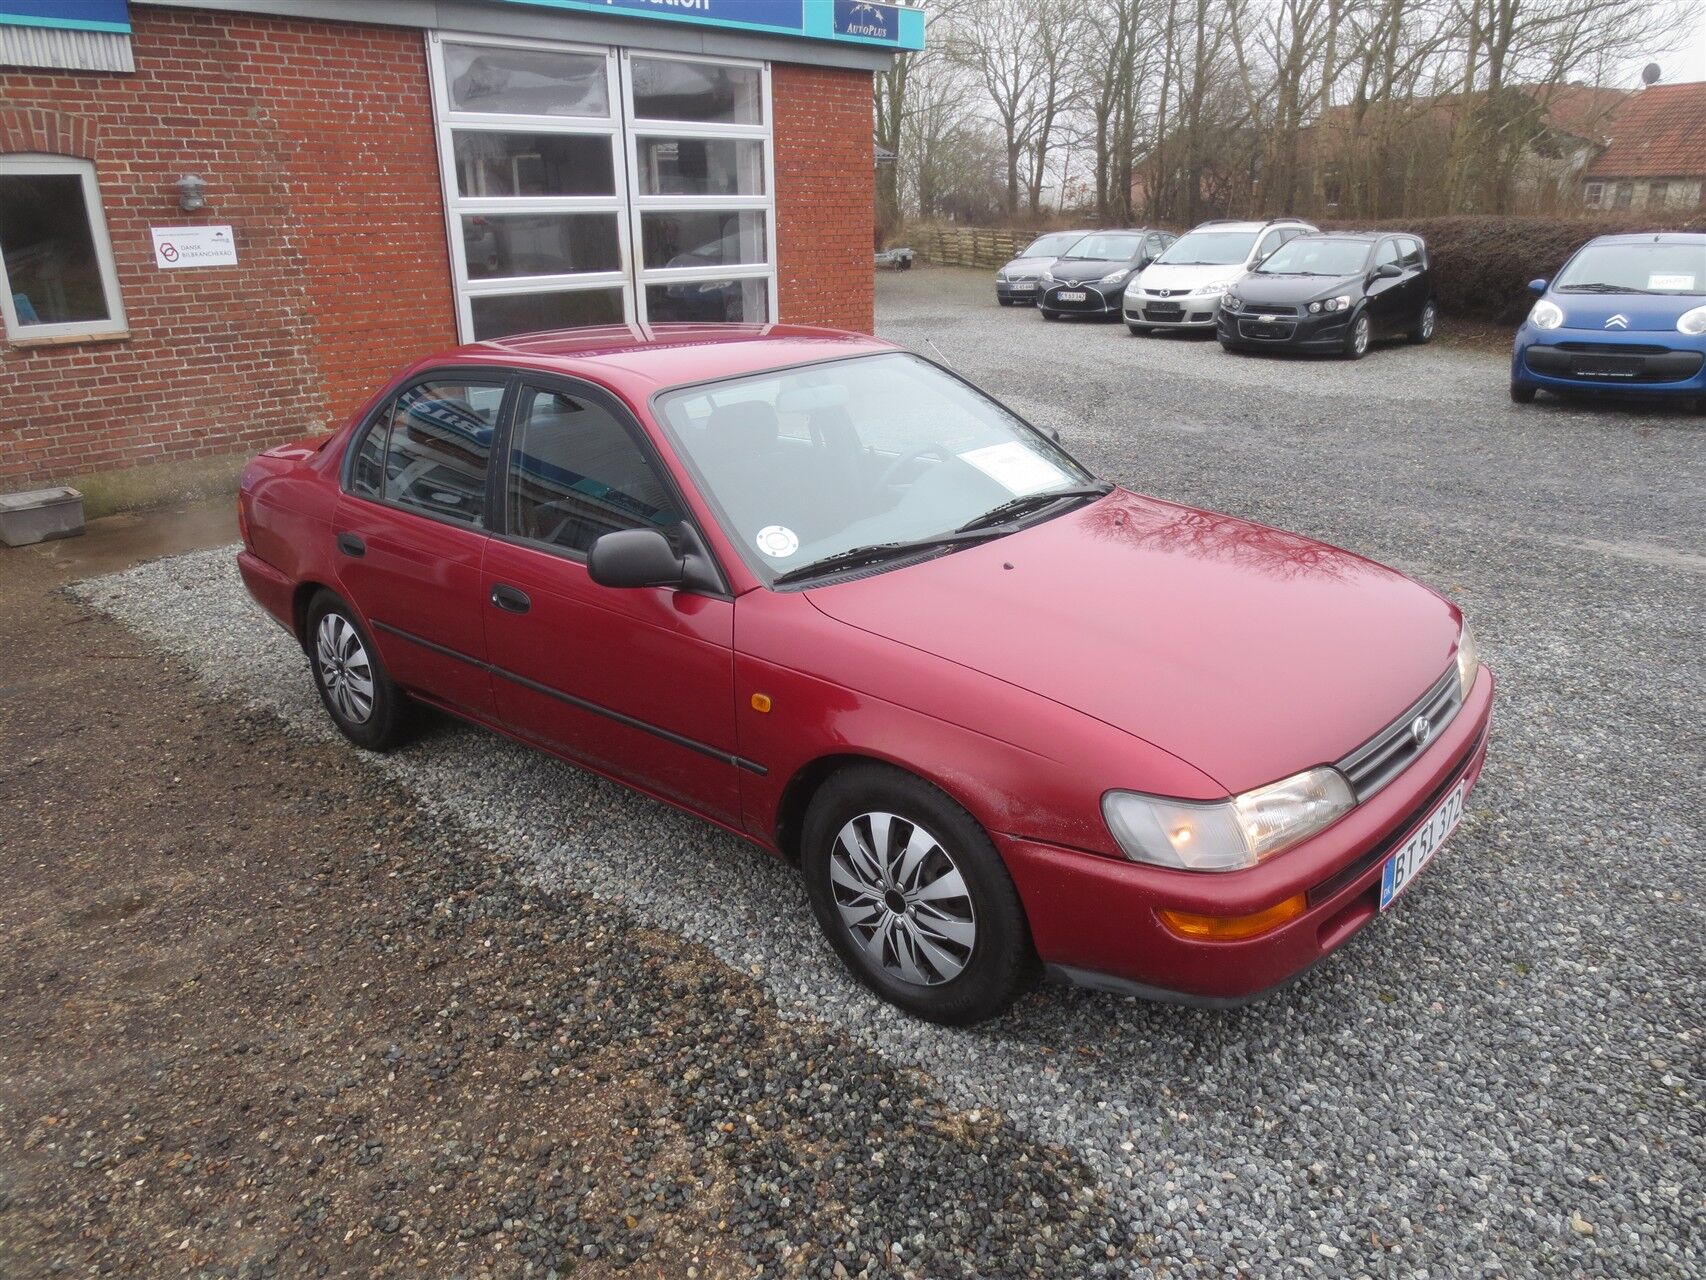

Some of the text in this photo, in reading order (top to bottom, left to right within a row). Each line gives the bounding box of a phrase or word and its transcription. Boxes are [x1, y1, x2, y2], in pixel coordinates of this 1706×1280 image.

[1394, 788, 1462, 890] BT 51 372
